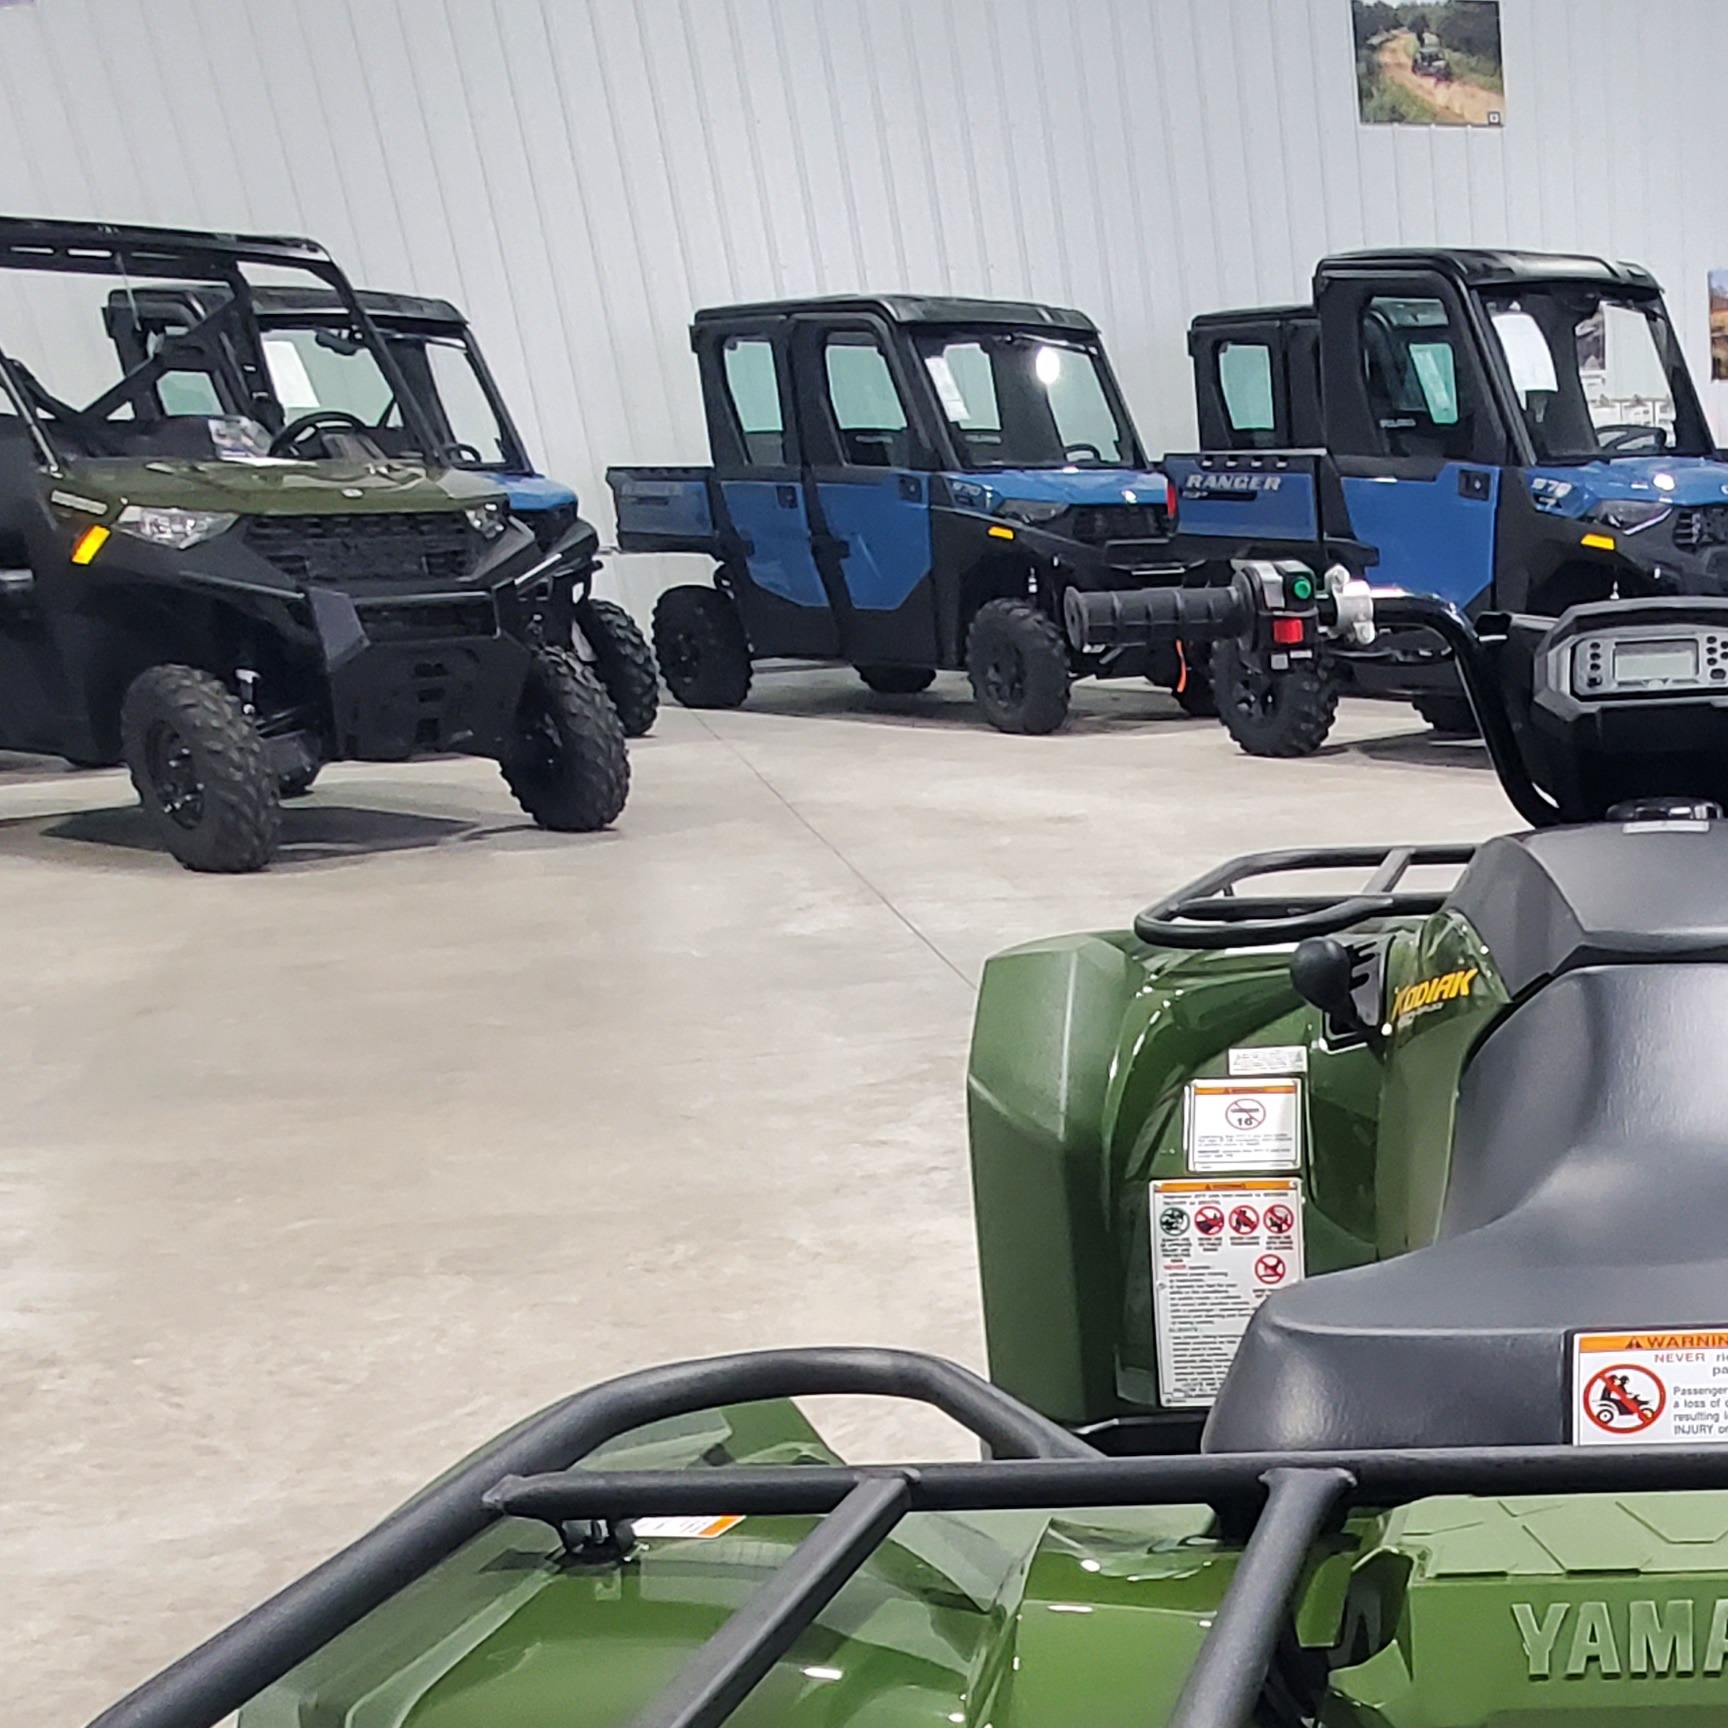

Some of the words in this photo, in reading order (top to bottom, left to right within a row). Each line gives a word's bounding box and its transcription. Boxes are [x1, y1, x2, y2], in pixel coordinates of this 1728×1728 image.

[1186, 474, 1282, 491] RANGER
[1390, 967, 1479, 1022] KODIAK
[1654, 1352, 1706, 1363] NEVER
[1684, 1399, 1706, 1408] loss
[1710, 1398, 1721, 1408] of
[1673, 1411, 1720, 1423] resulting
[1674, 1424, 1714, 1435] INJURY
[1718, 1426, 1728, 1434] or
